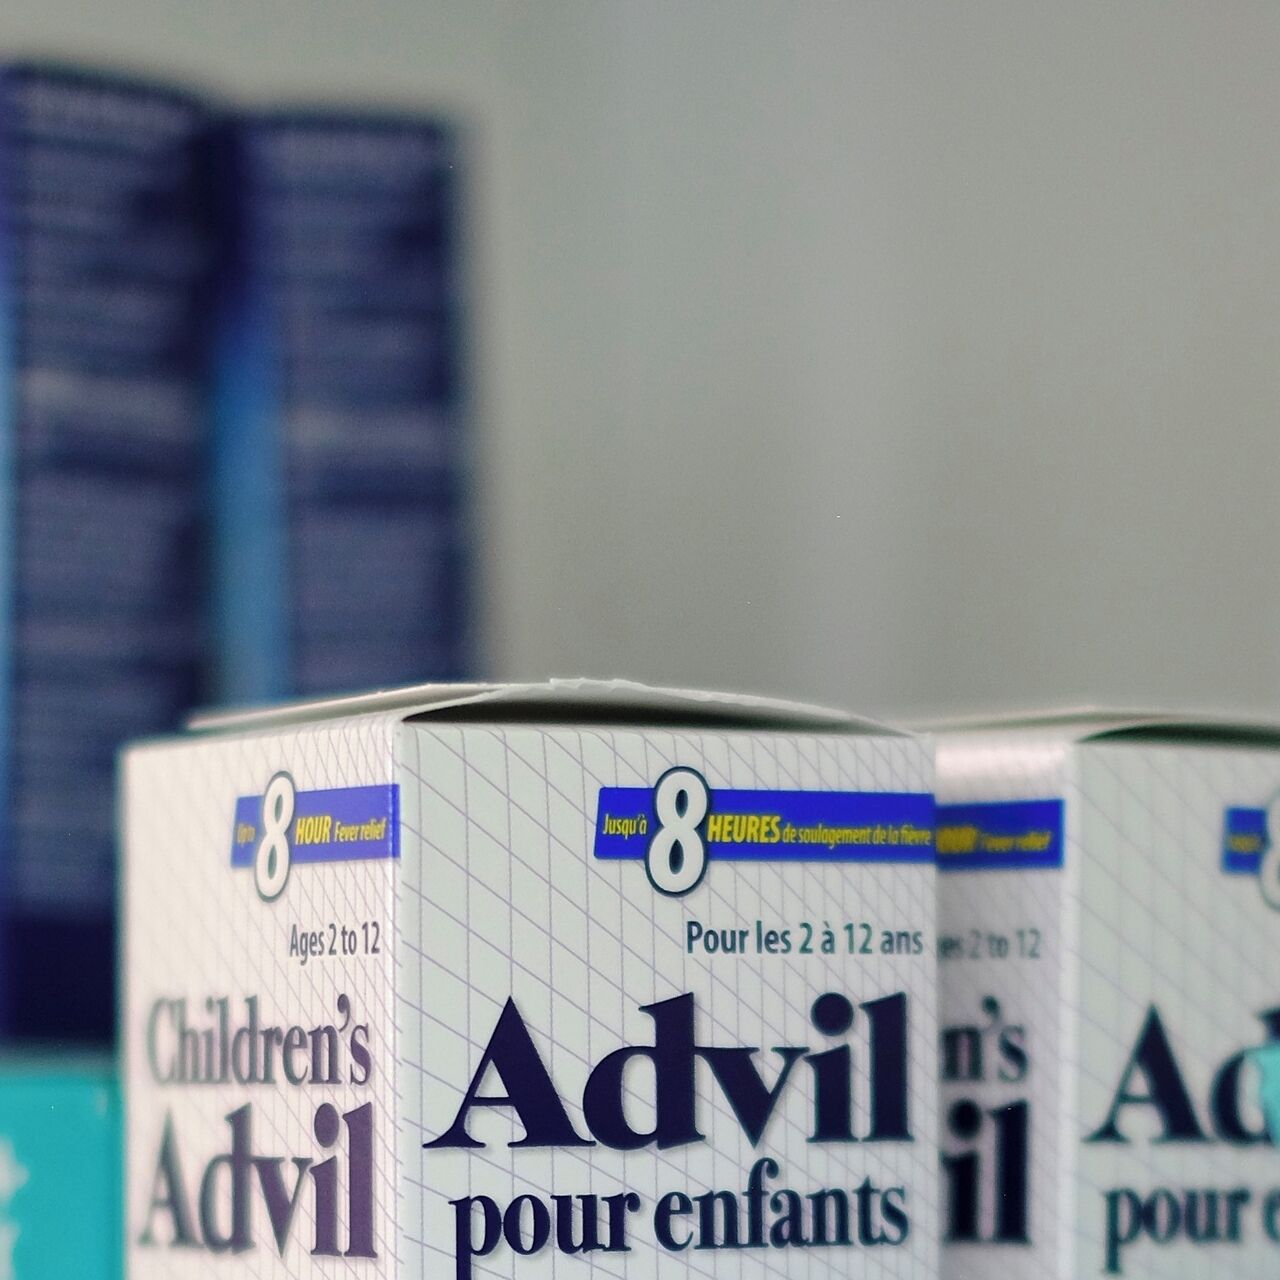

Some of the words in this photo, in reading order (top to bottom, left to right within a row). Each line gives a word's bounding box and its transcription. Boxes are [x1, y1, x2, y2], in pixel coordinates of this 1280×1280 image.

[254, 770, 296, 903] 8
[295, 815, 331, 845] HOUR
[334, 821, 360, 842] Fever
[360, 817, 386, 841] relief
[602, 813, 647, 840] Jusqu'à
[645, 766, 709, 897] 8
[707, 815, 781, 843] HEURES
[783, 823, 797, 843] de
[798, 823, 871, 849] soulagement
[873, 824, 886, 845] de
[888, 824, 898, 845] la
[289, 924, 324, 966] Ages
[328, 924, 337, 956] 2
[341, 926, 357, 955] to
[361, 921, 381, 955] 12
[687, 920, 749, 954] Pour
[756, 920, 792, 954] les
[799, 922, 814, 954] 2
[821, 920, 836, 954] à
[844, 922, 873, 954] 12
[880, 930, 923, 954] ans
[146, 993, 372, 1086] Children's
[422, 992, 915, 1150] Advil
[138, 1101, 378, 1259] Advil
[654, 1157, 910, 1252] enfants
[1104, 1186, 1251, 1276] pour
